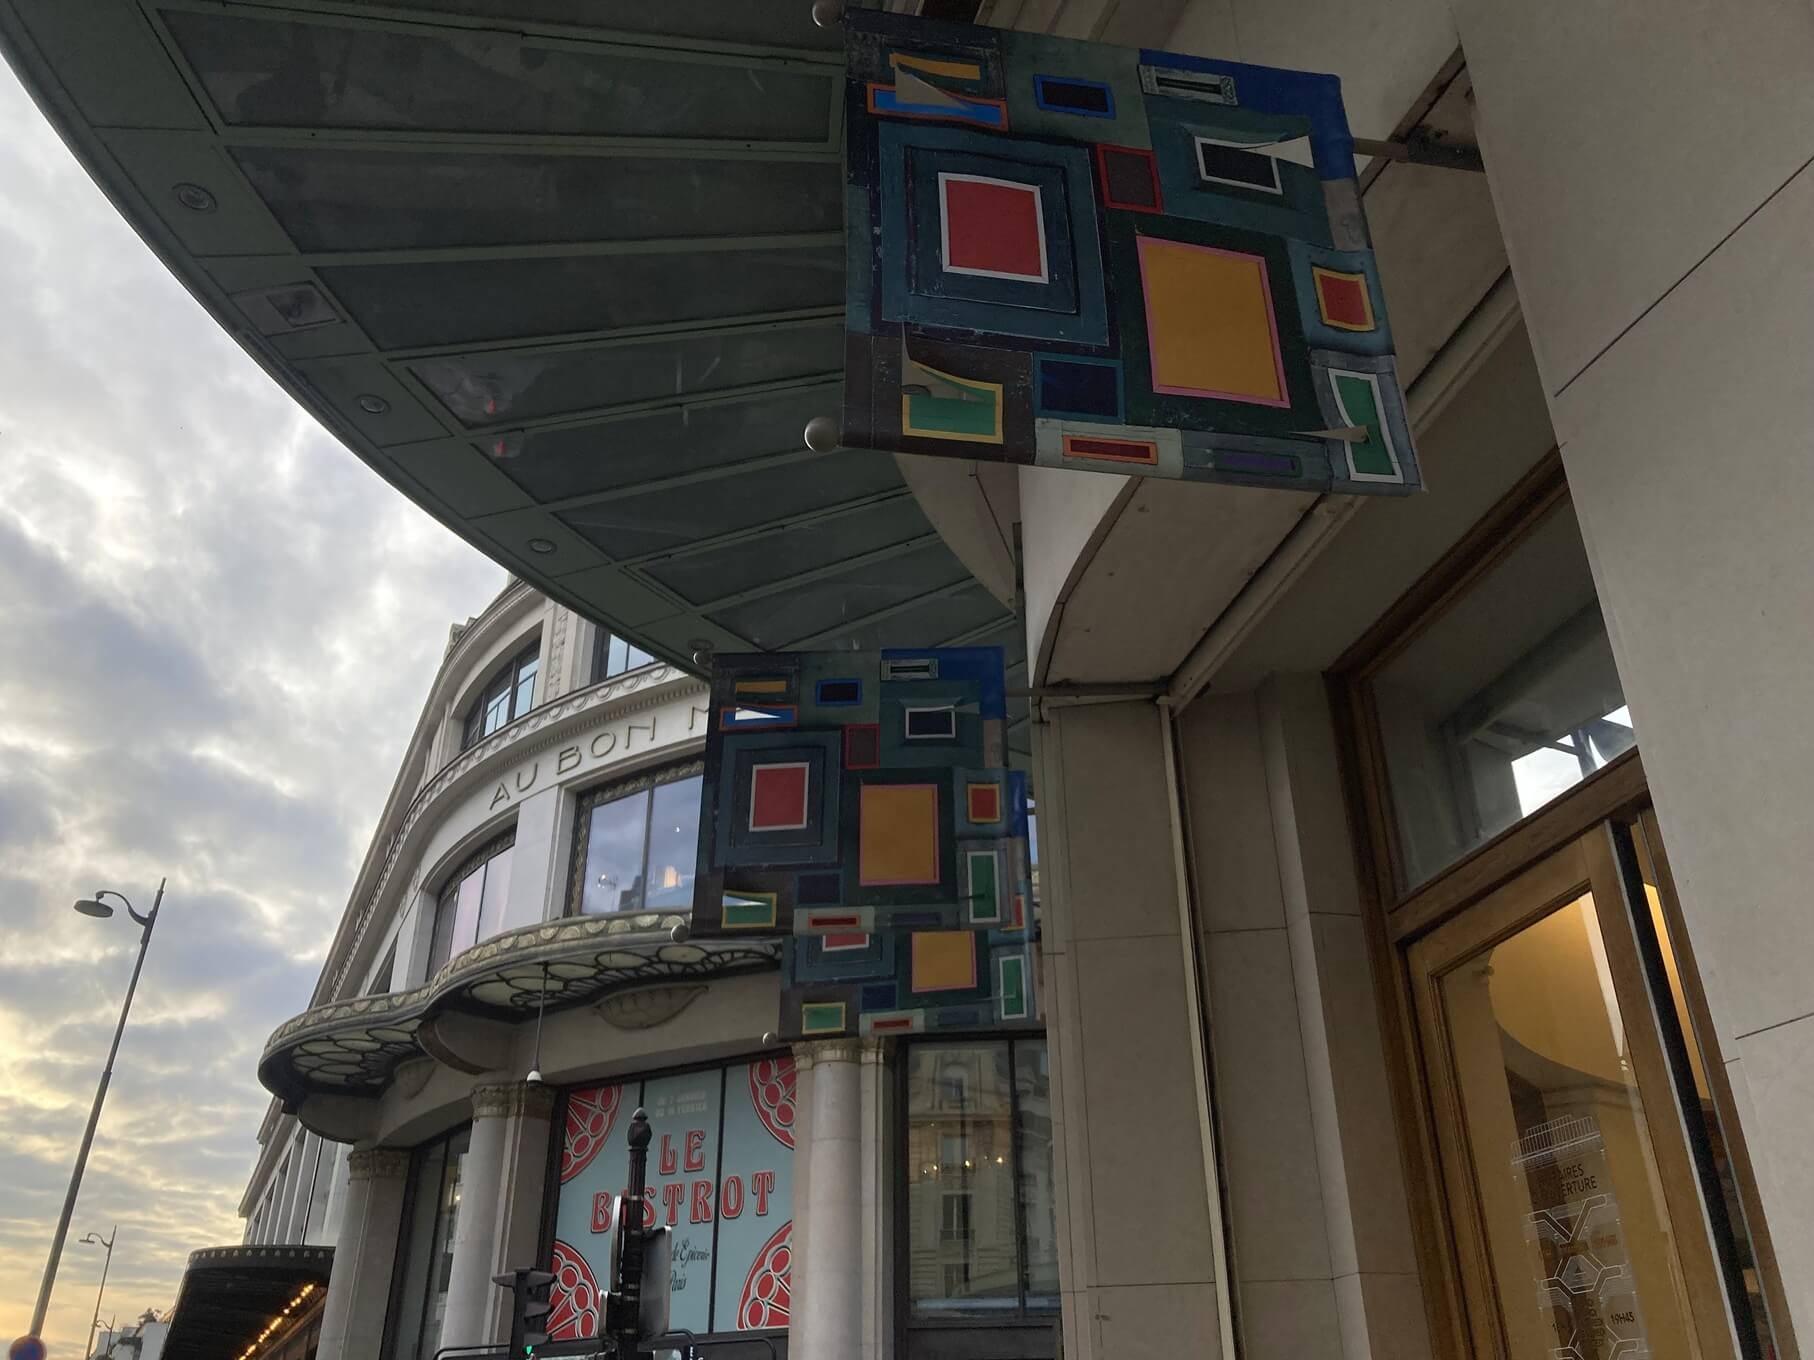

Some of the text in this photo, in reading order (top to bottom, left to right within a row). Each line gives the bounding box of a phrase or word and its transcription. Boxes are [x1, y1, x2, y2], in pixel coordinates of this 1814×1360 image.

[489, 763, 538, 810] AU
[556, 715, 657, 776] BON
[659, 1130, 706, 1174] LE
